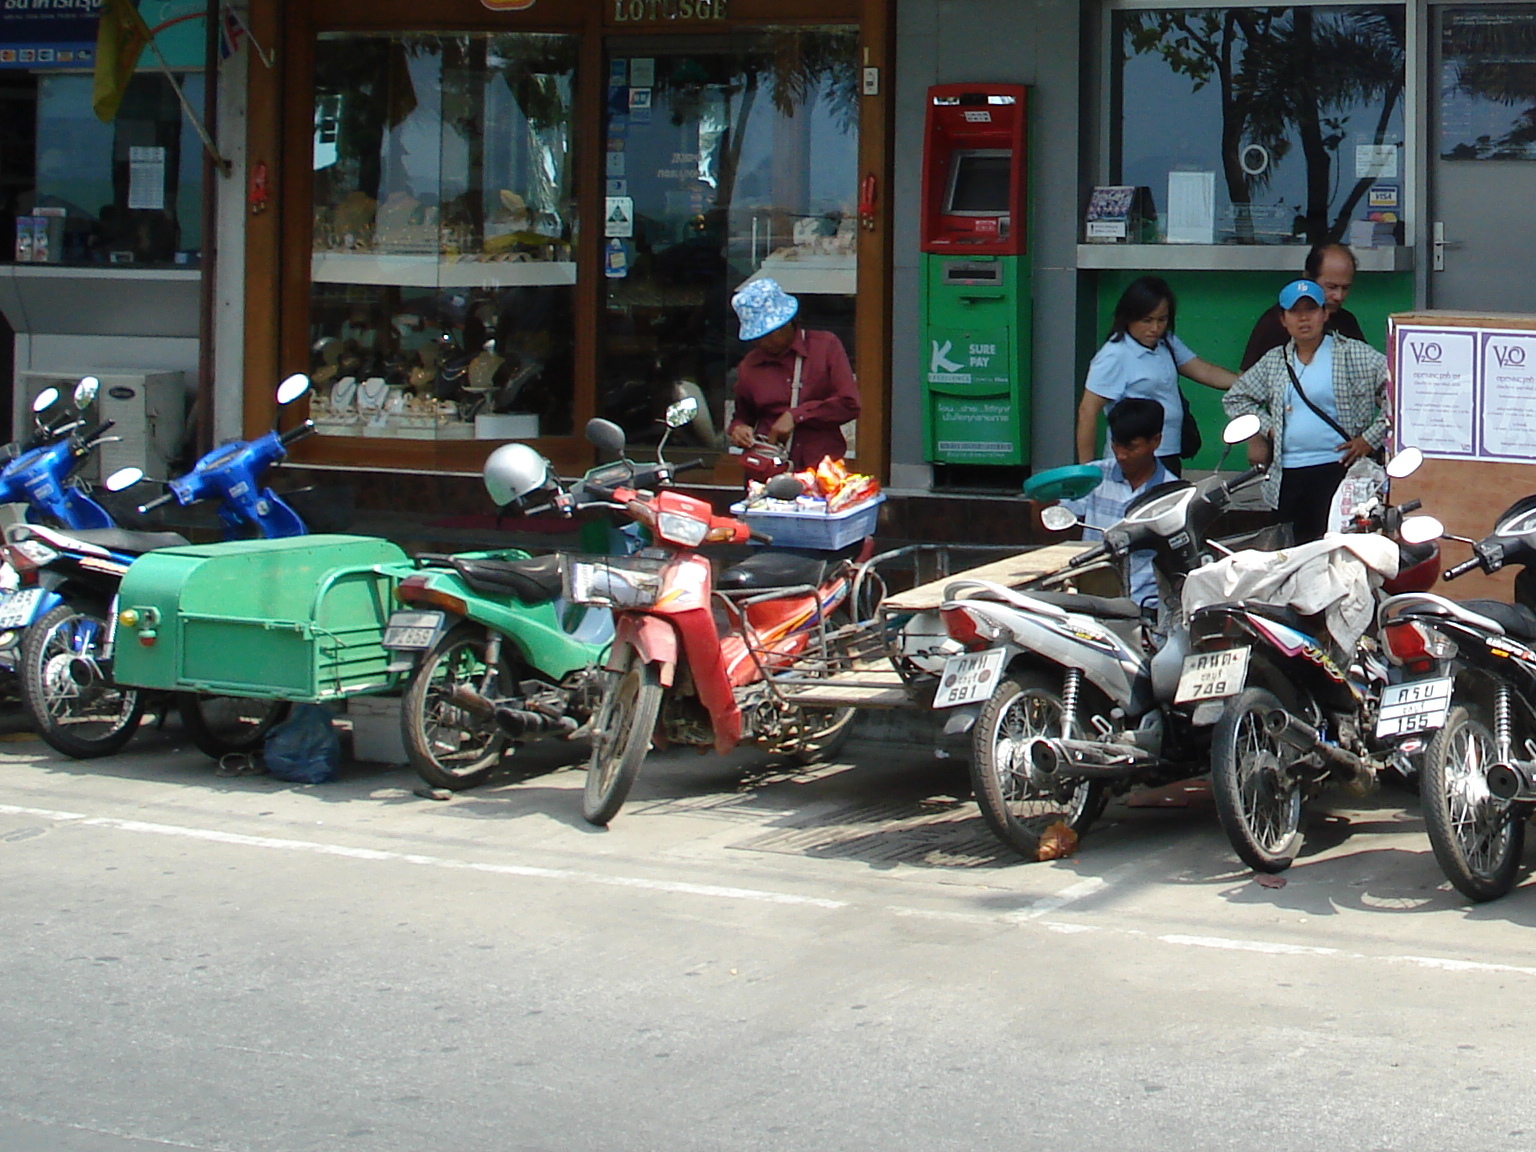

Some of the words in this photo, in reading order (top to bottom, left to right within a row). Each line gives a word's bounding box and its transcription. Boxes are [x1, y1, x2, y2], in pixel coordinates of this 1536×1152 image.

[1375, 192, 1392, 201] VISA
[969, 344, 995, 355] SURE
[970, 357, 989, 367] PAY
[948, 684, 977, 702] 691
[1193, 681, 1227, 698] 749
[1398, 712, 1429, 733] 155
